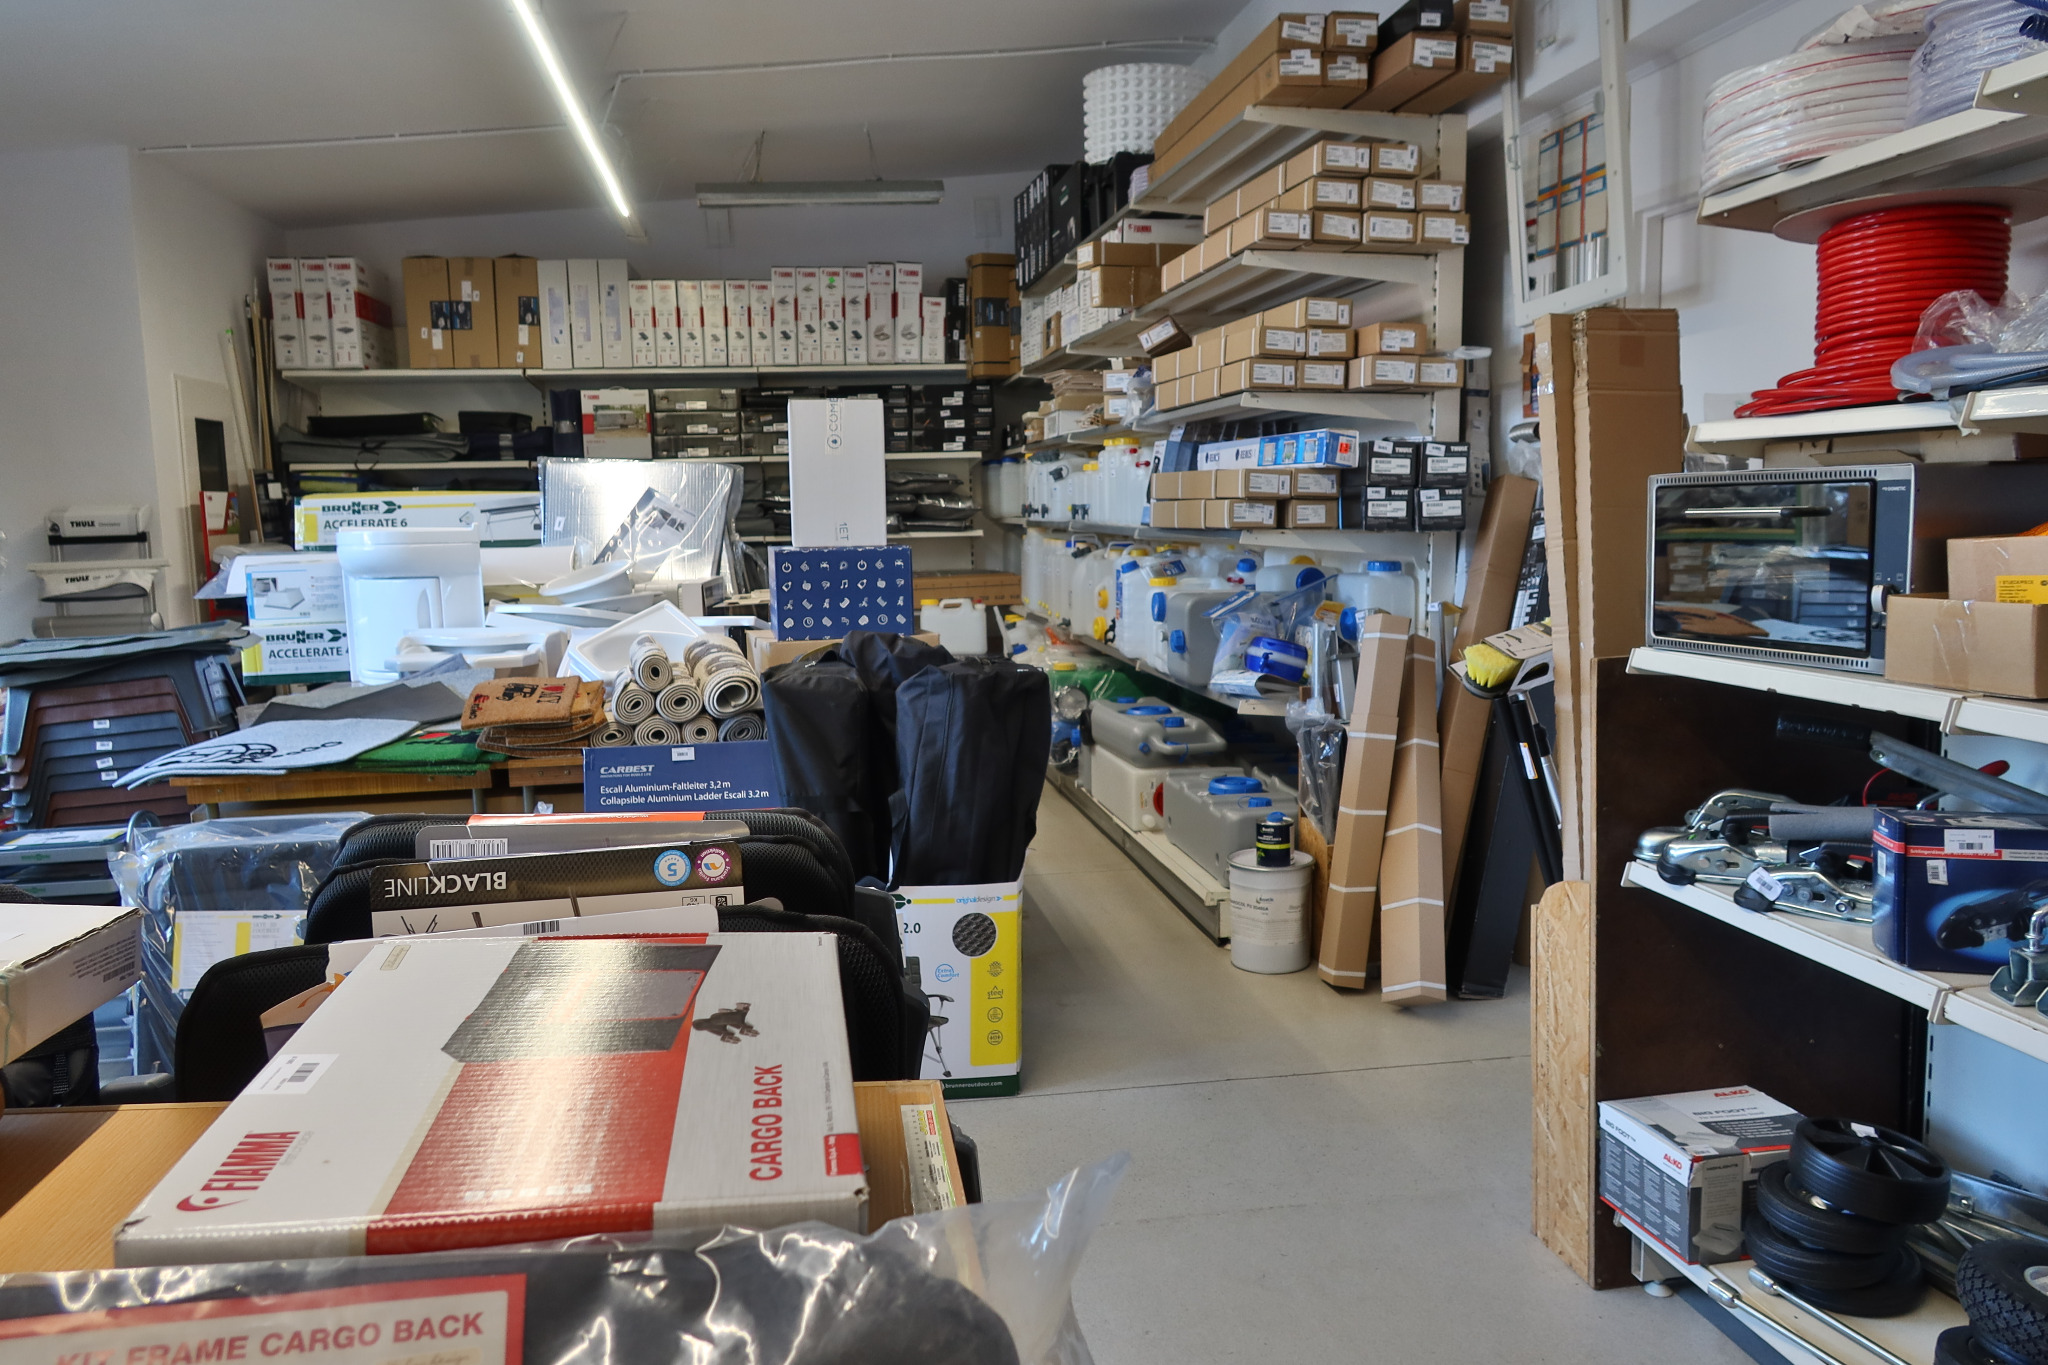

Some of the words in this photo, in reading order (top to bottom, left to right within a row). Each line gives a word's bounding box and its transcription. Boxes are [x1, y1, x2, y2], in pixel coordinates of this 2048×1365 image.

[70, 520, 96, 528] THULE
[400, 517, 408, 528] 6
[65, 575, 90, 584] THULE
[268, 646, 343, 659] ACCELERATE
[600, 764, 655, 775] CARBEST
[624, 780, 708, 793] Aluminium-Faltleiter
[600, 795, 646, 806] Collapsible
[647, 793, 693, 804] Aluminium
[694, 791, 722, 801] Ladder
[666, 862, 678, 877] 5
[384, 871, 507, 899] BLACKLINE
[987, 987, 1004, 997] steel
[754, 1063, 784, 1107] BACK
[749, 1107, 784, 1181] CARGO
[199, 1130, 301, 1191] FIAMMA
[126, 1335, 250, 1365] FRAME
[260, 1323, 381, 1358] CARGO
[393, 1311, 484, 1344] BACK
